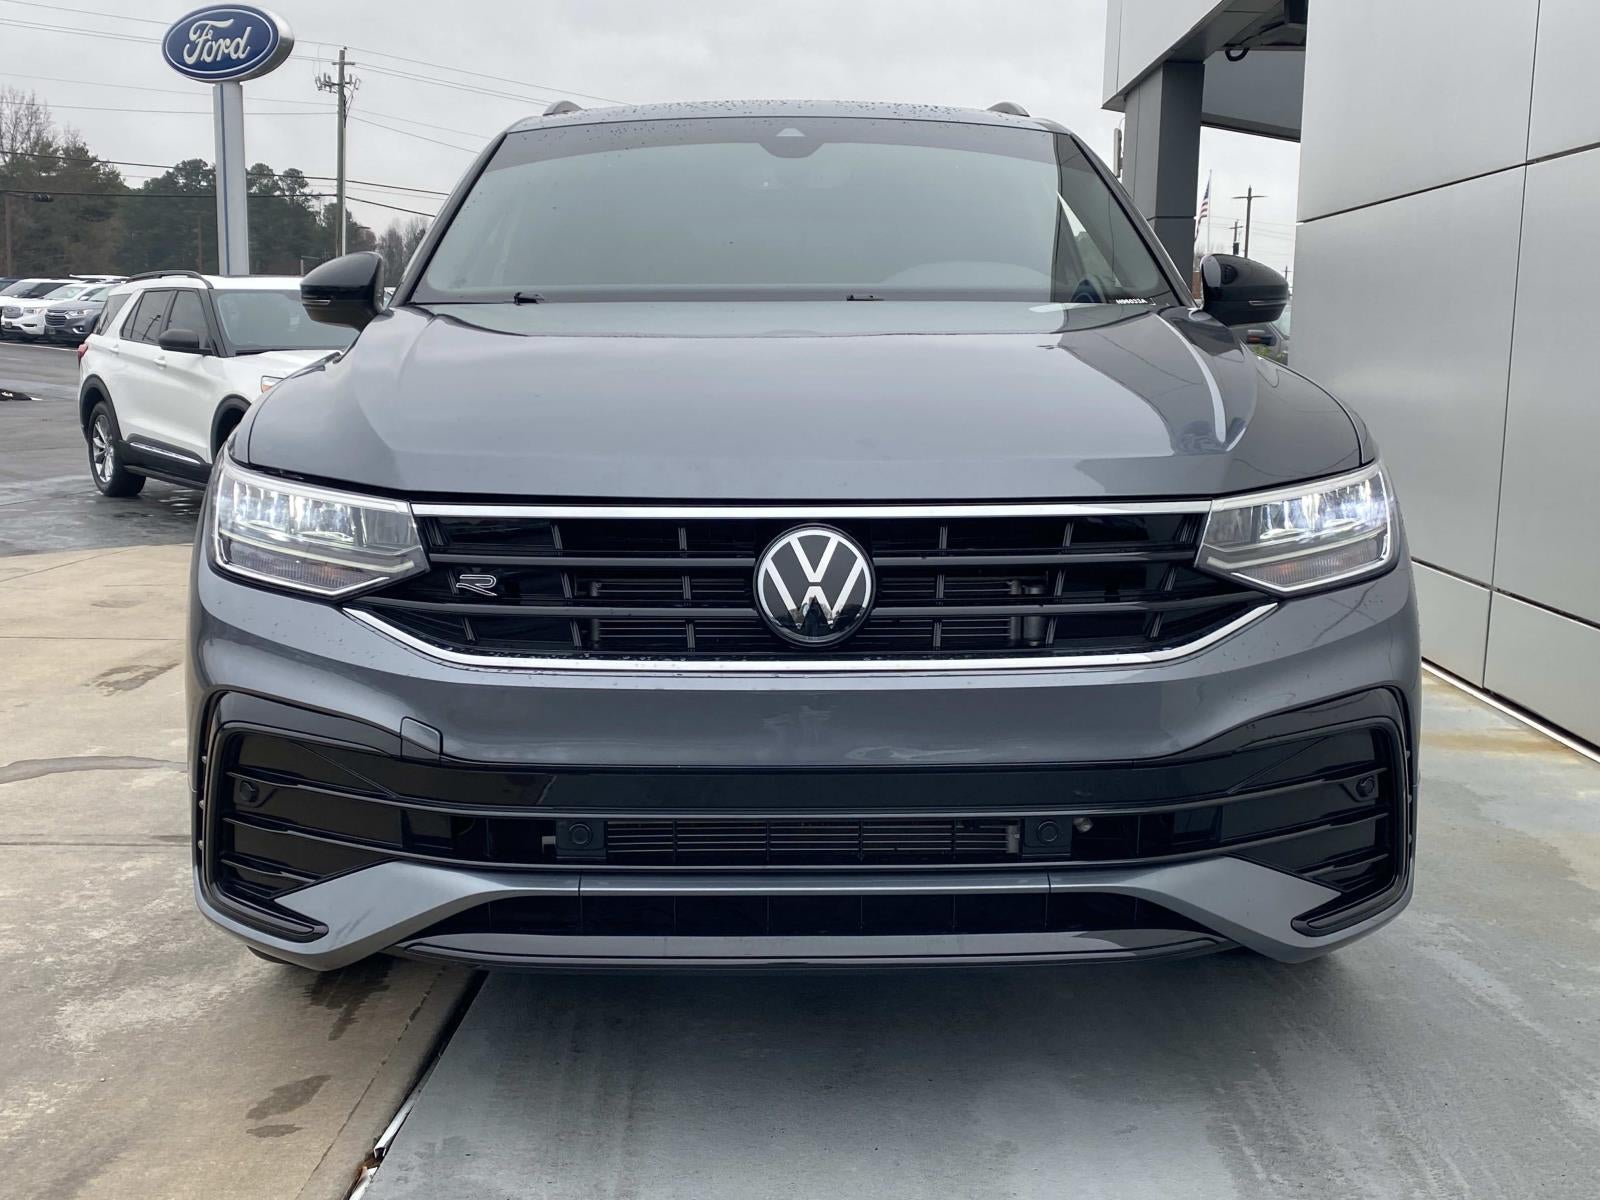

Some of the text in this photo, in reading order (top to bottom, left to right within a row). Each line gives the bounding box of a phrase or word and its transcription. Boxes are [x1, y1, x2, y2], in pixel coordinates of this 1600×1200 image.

[183, 19, 252, 65] Ford
[456, 574, 497, 596] R
[761, 533, 868, 632] VW
